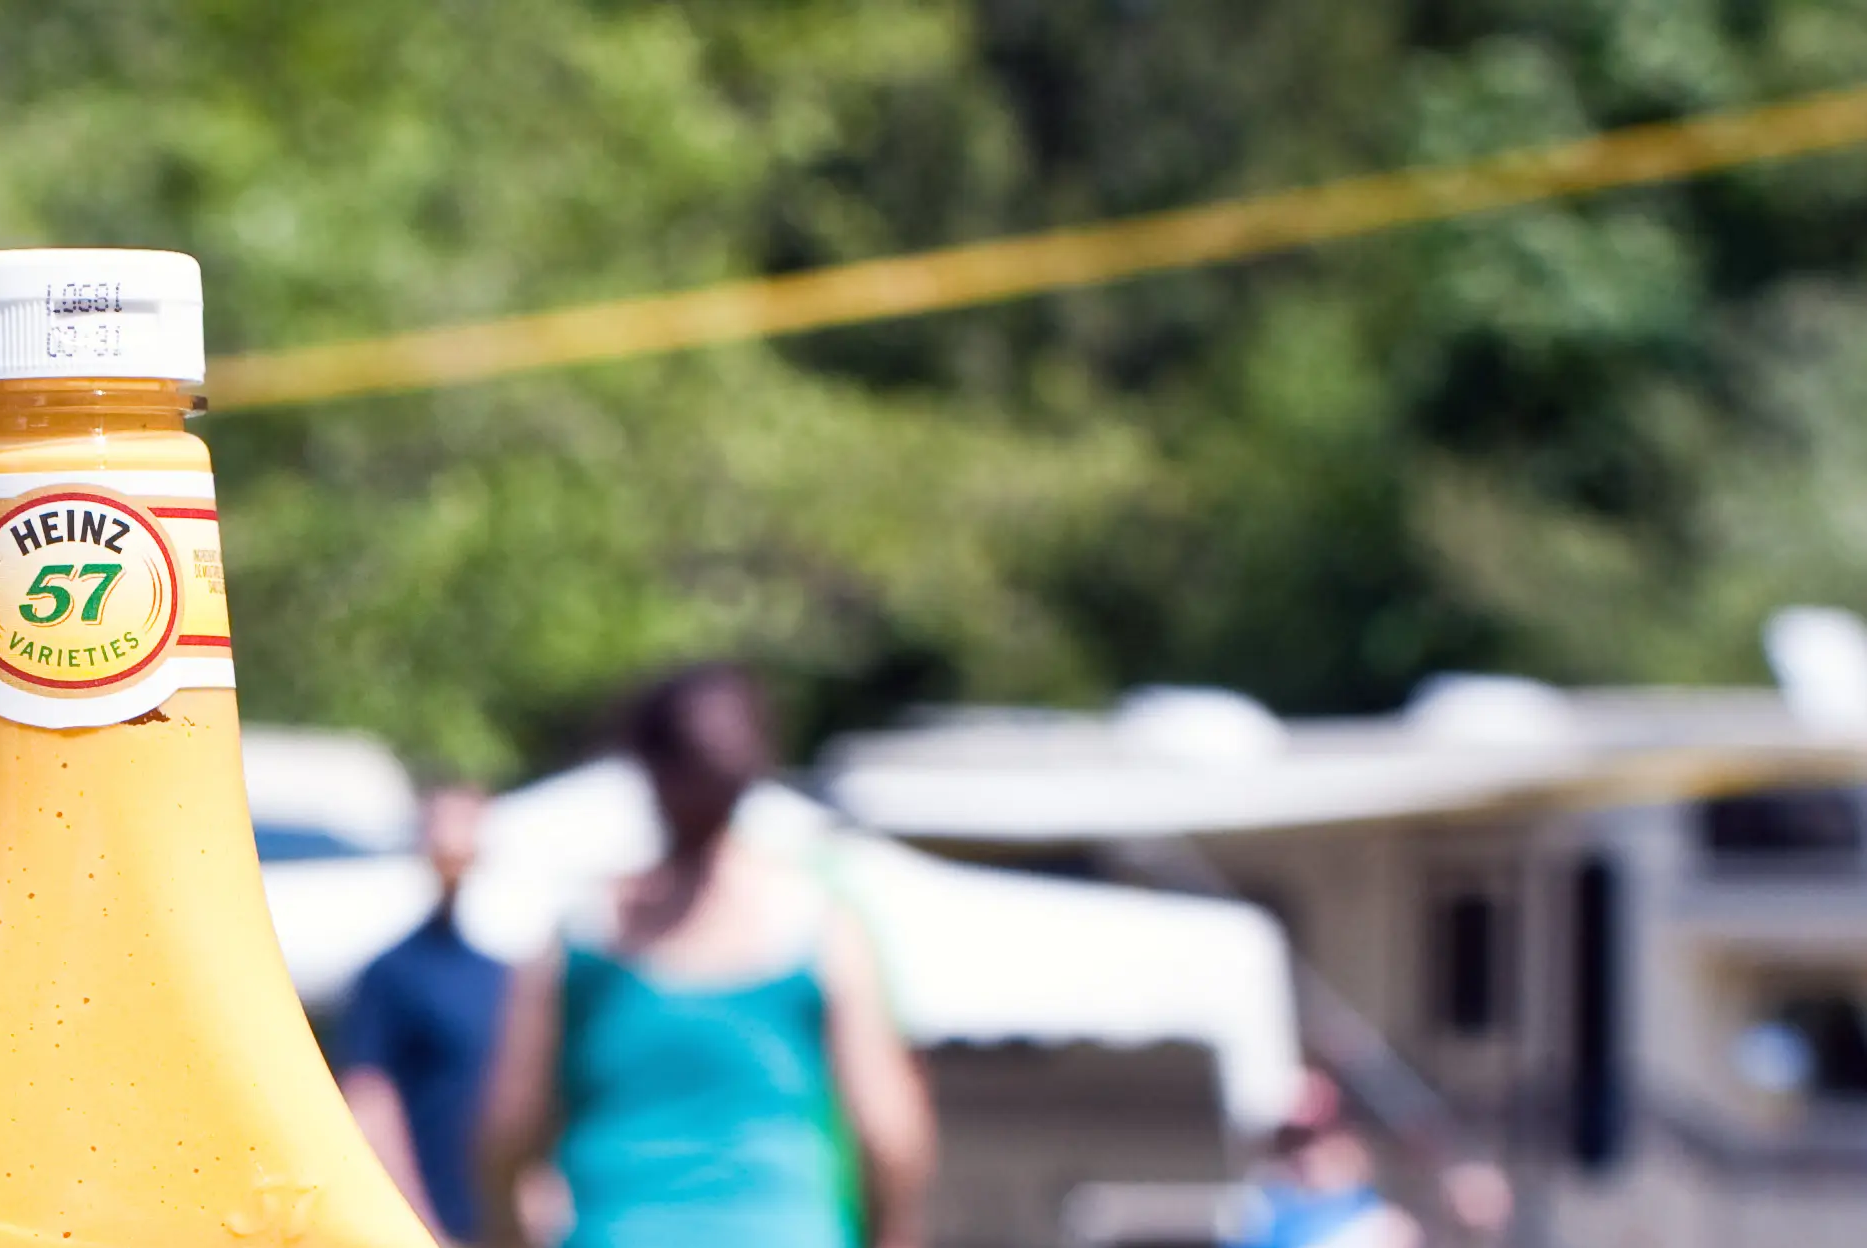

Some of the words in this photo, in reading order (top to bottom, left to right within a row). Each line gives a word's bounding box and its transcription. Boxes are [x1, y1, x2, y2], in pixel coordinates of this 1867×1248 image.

[10, 510, 131, 556] HEINZ
[19, 563, 125, 625] 57
[9, 631, 139, 668] VARIETIES
